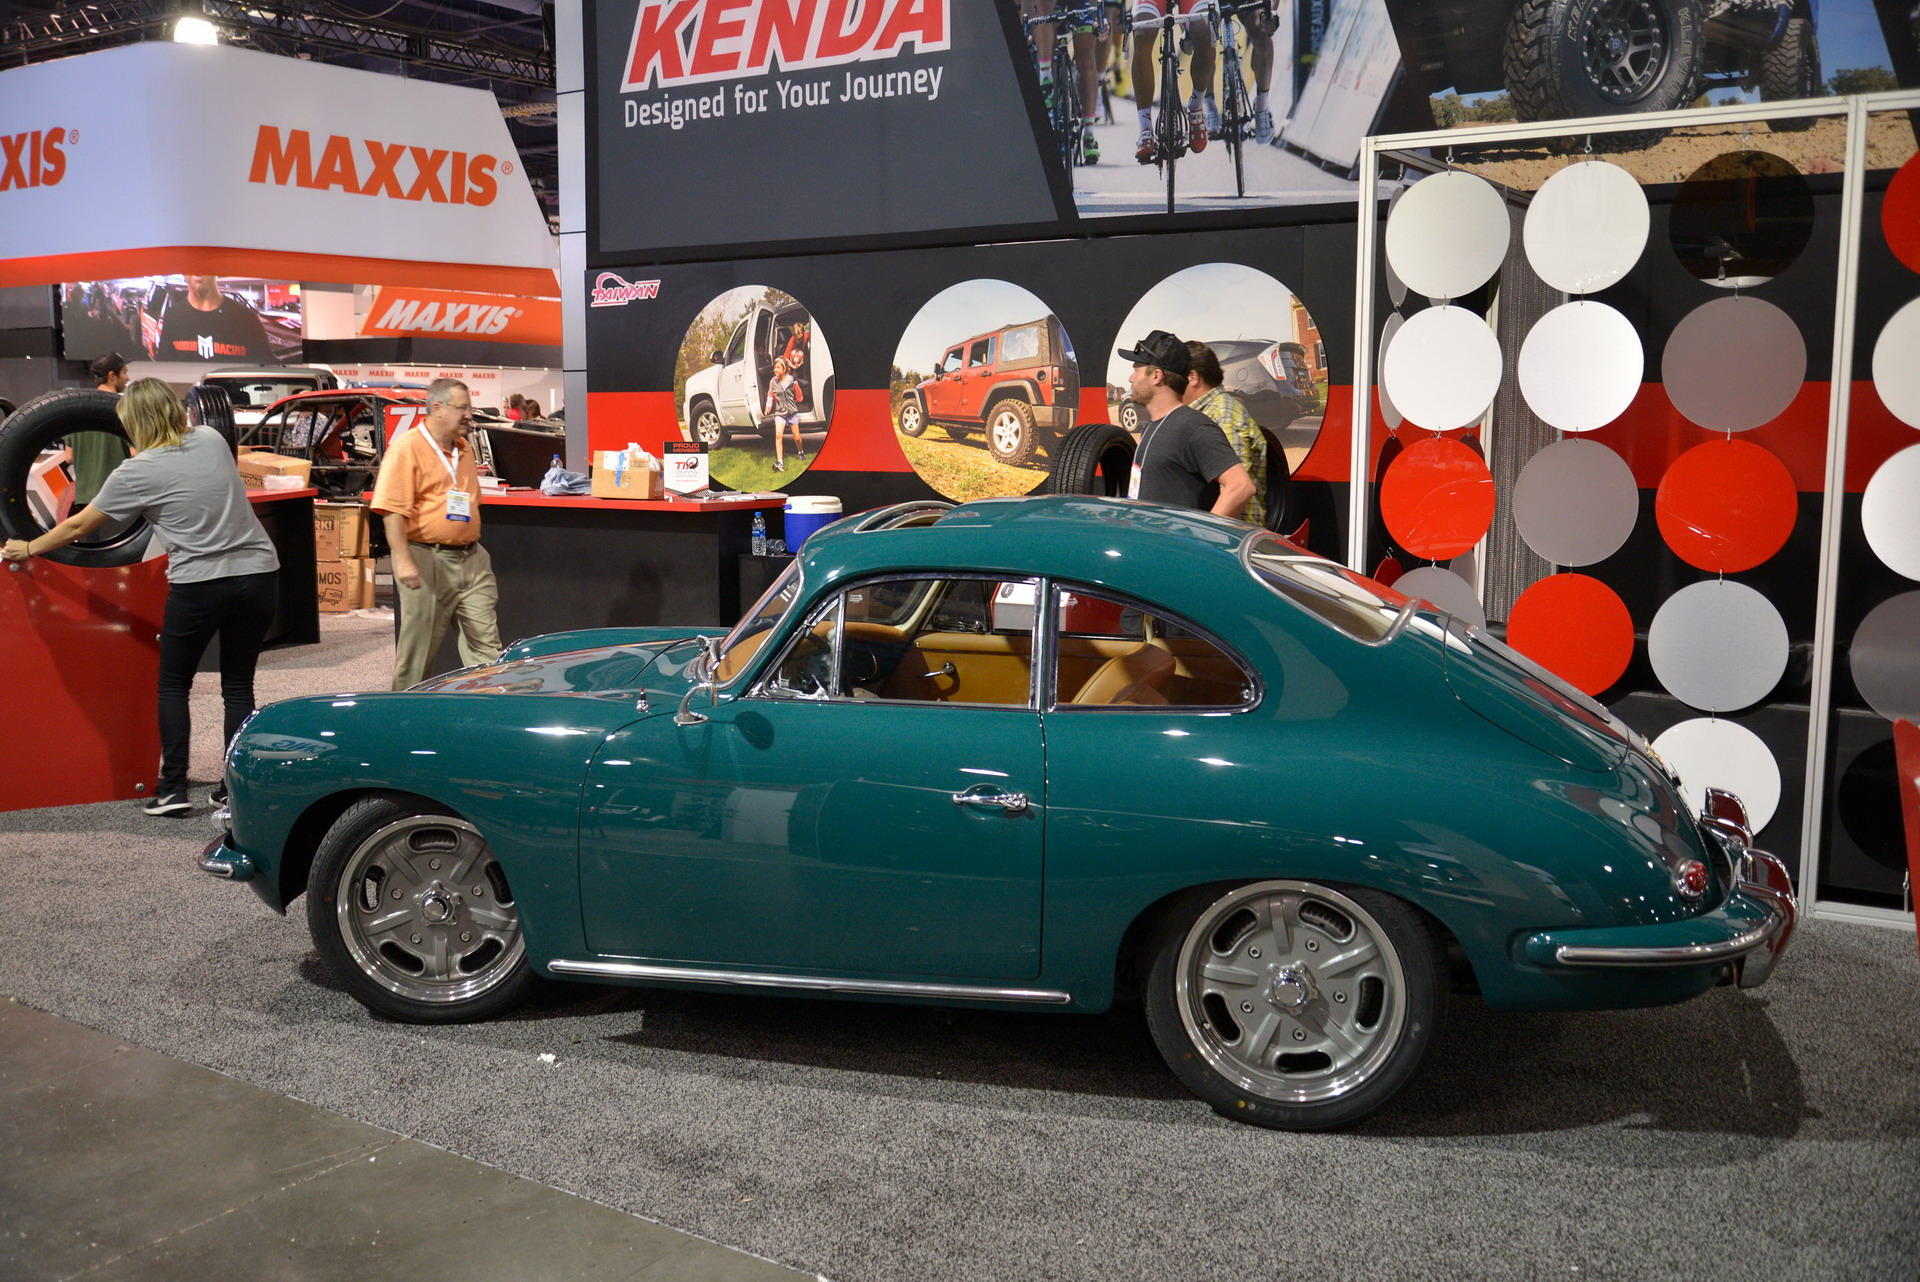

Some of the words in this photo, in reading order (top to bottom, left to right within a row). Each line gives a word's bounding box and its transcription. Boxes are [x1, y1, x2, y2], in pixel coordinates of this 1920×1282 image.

[621, 0, 950, 93] KENDA
[1665, 6, 1693, 99] KLEVER
[624, 87, 724, 130] Designed
[734, 84, 768, 113] for
[776, 79, 831, 110] Your
[840, 65, 943, 102] Journey
[248, 124, 498, 207] MAXXIS
[592, 279, 660, 305] TAIWAN
[375, 299, 515, 335] MAXXIS
[213, 342, 247, 356] RACING
[388, 407, 427, 445] 7
[319, 572, 342, 585] MOS
